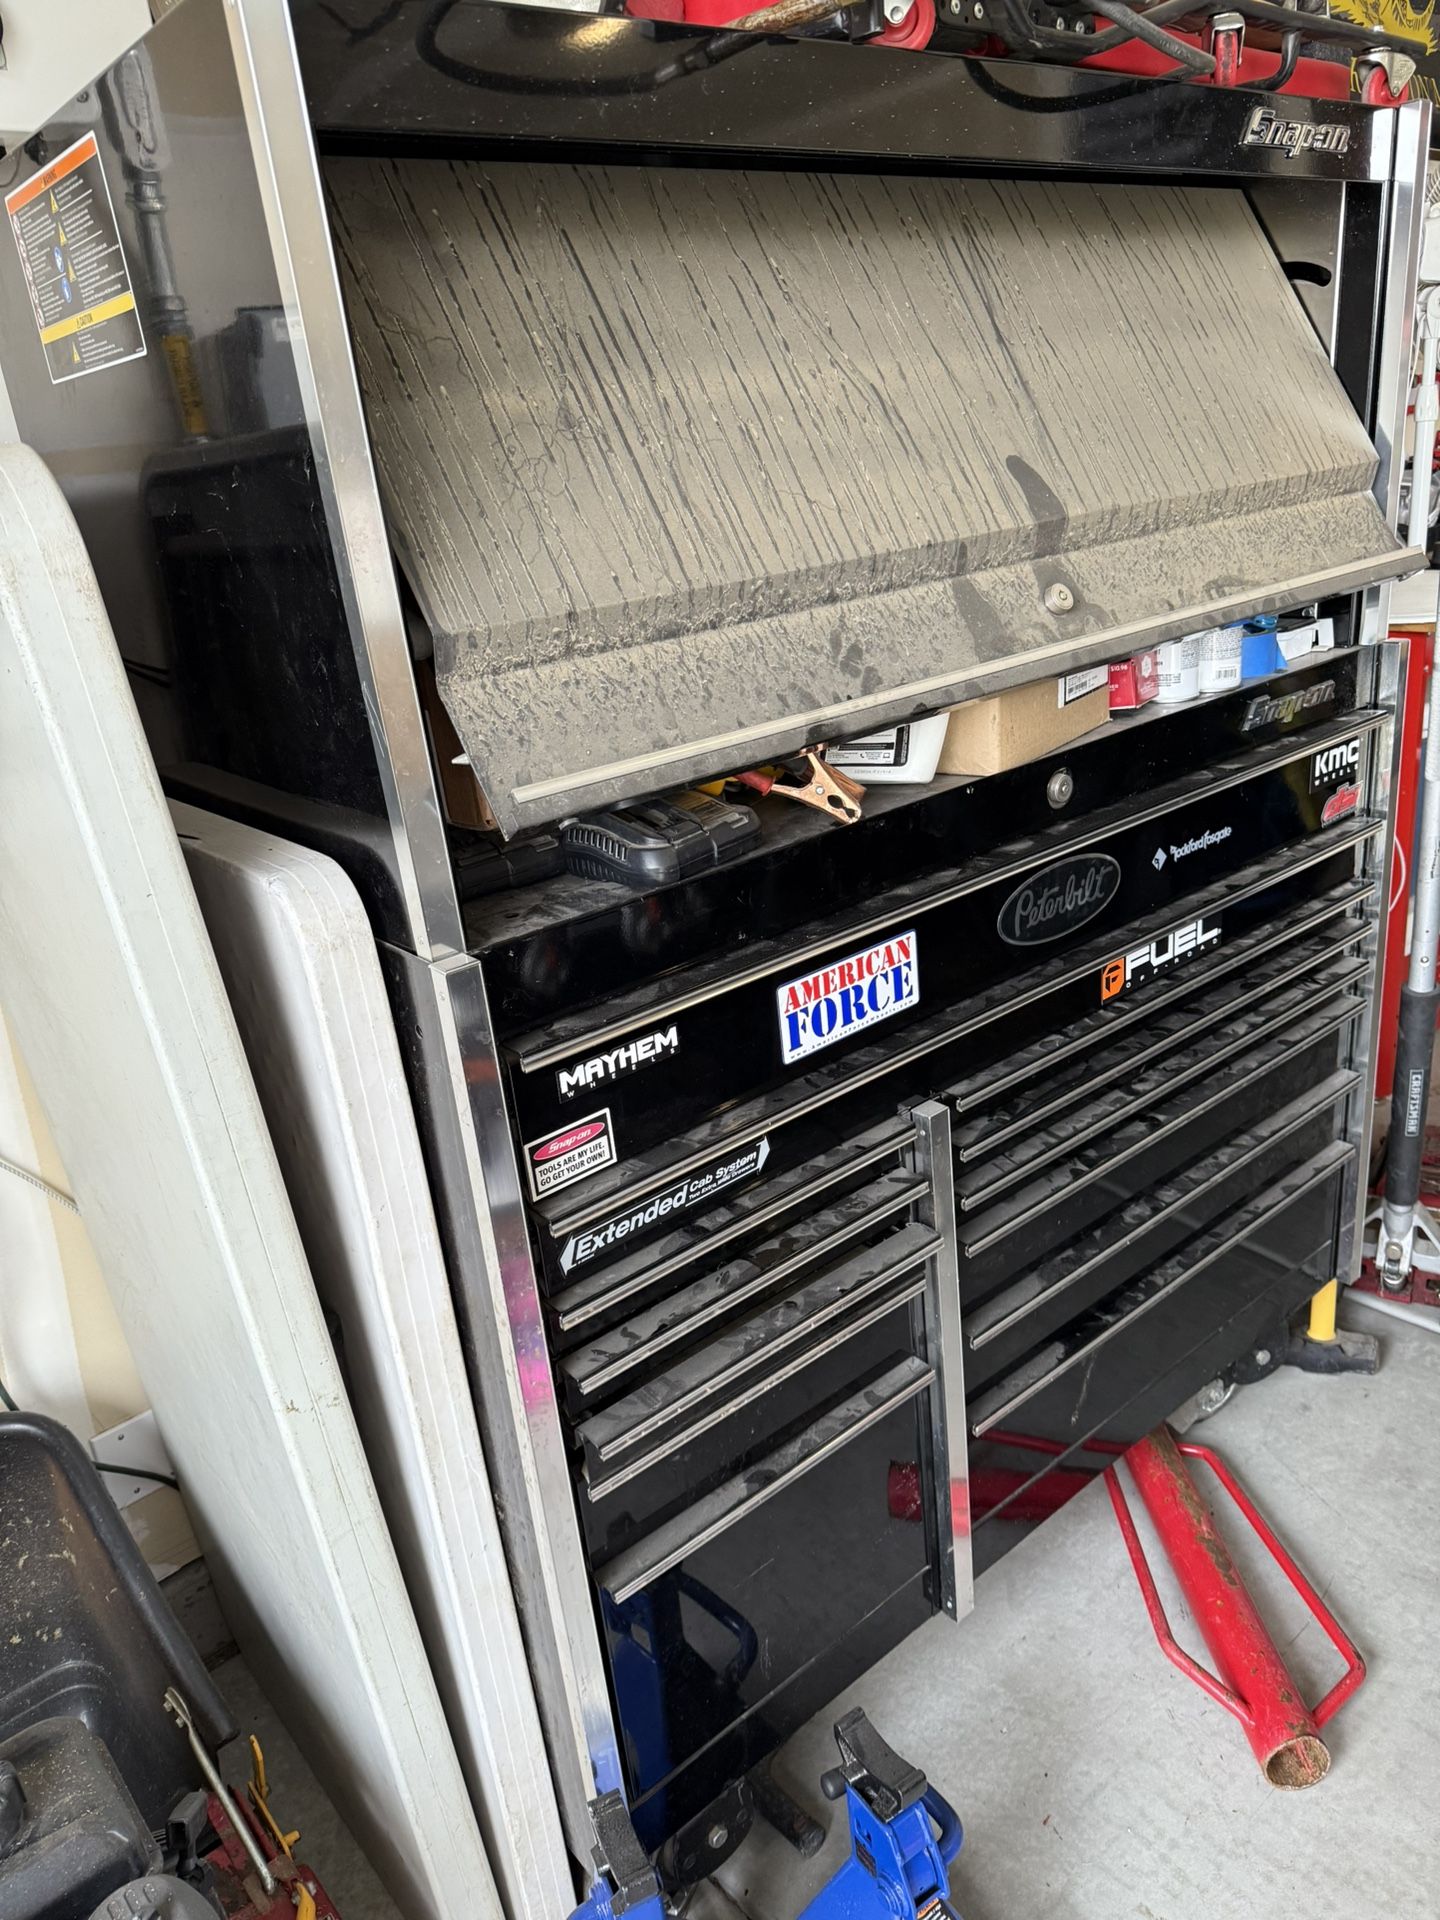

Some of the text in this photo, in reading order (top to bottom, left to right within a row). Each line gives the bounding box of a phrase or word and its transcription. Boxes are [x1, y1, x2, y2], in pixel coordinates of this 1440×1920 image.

[1241, 106, 1351, 157] Snap-on
[1315, 739, 1360, 777] KMC
[1014, 864, 1113, 937] Peterbilt
[784, 936, 911, 1014] AMERICAN
[1126, 919, 1219, 980] FUEL
[786, 961, 914, 1052] FORCE
[559, 1026, 679, 1094] MAYHEM
[1407, 1073, 1422, 1133] CRAFTSMAN
[539, 1162, 562, 1178] TOOLS
[563, 1154, 576, 1165] ARE
[577, 1148, 589, 1160] MY
[540, 1150, 606, 1187] GO GET YOUR OWN!
[575, 1184, 688, 1260] Extended
[689, 1174, 713, 1192] Cab
[715, 1151, 757, 1179] System
